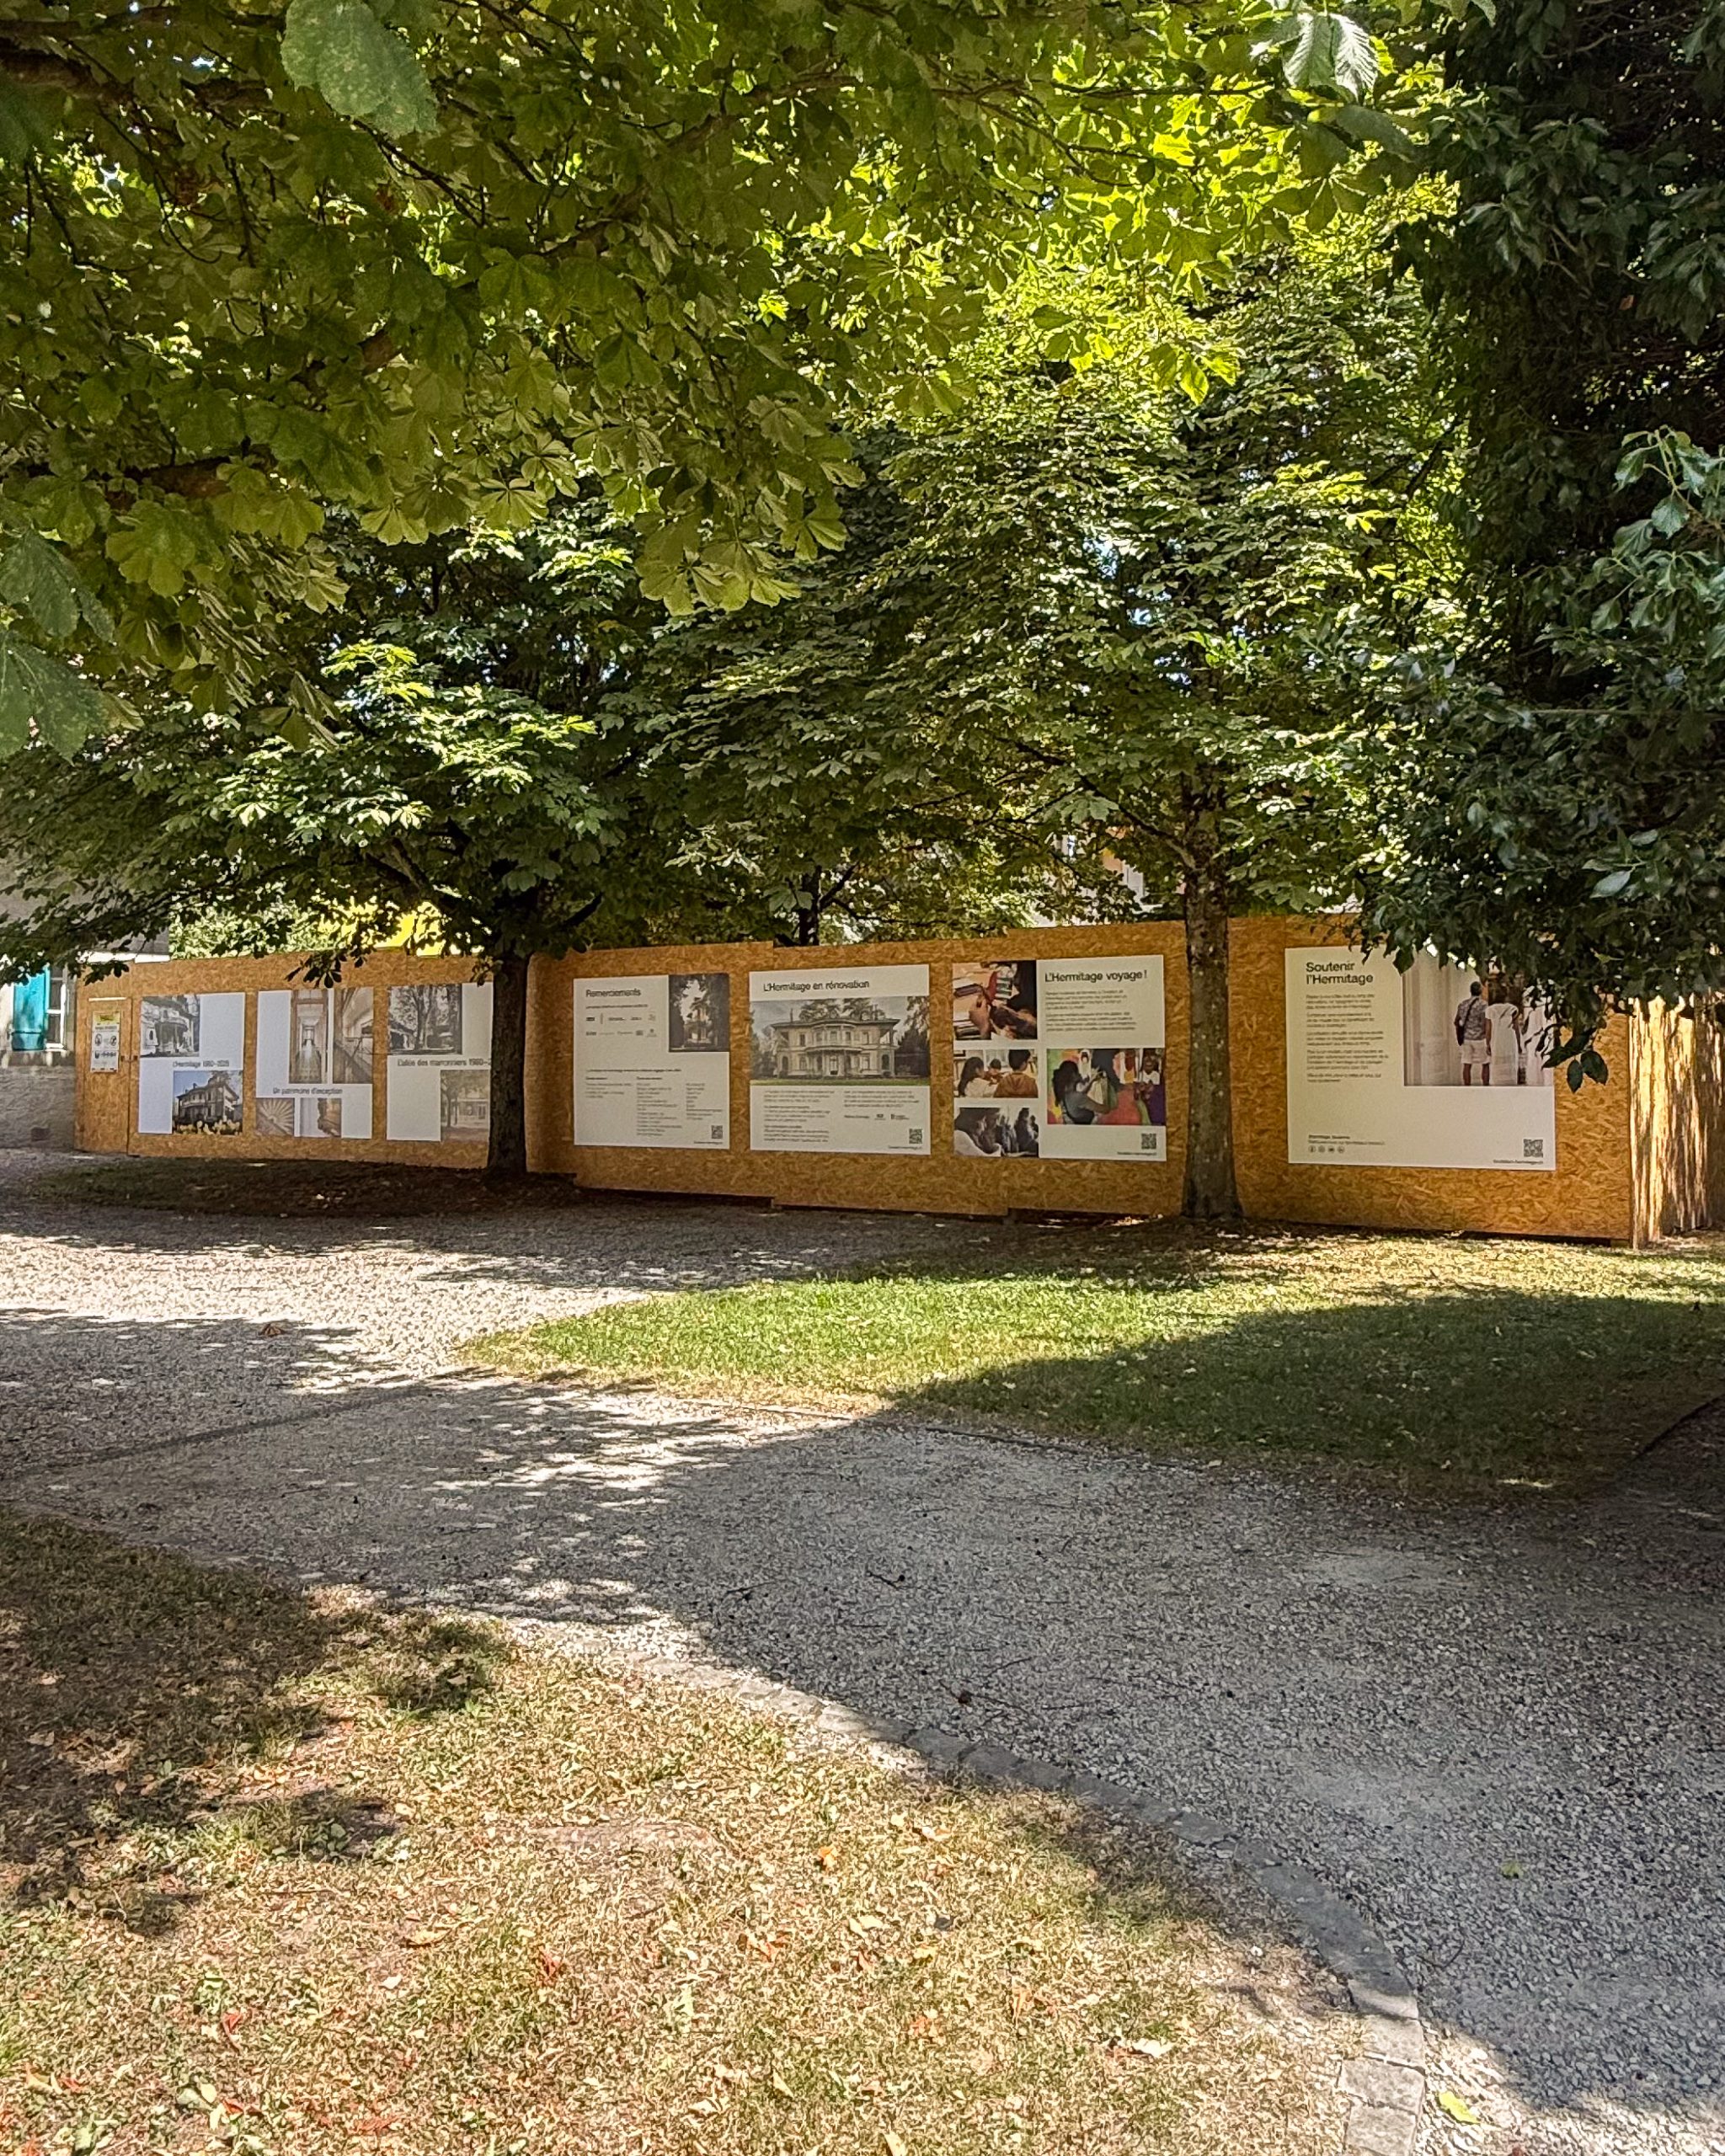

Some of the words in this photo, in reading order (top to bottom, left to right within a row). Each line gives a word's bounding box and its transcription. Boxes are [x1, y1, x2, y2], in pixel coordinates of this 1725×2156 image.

[1306, 962, 1355, 973] Soutenir
[1044, 972, 1103, 984] L'Hermitage
[1306, 974, 1374, 985] l'Hermitage
[825, 980, 870, 990] rénovation
